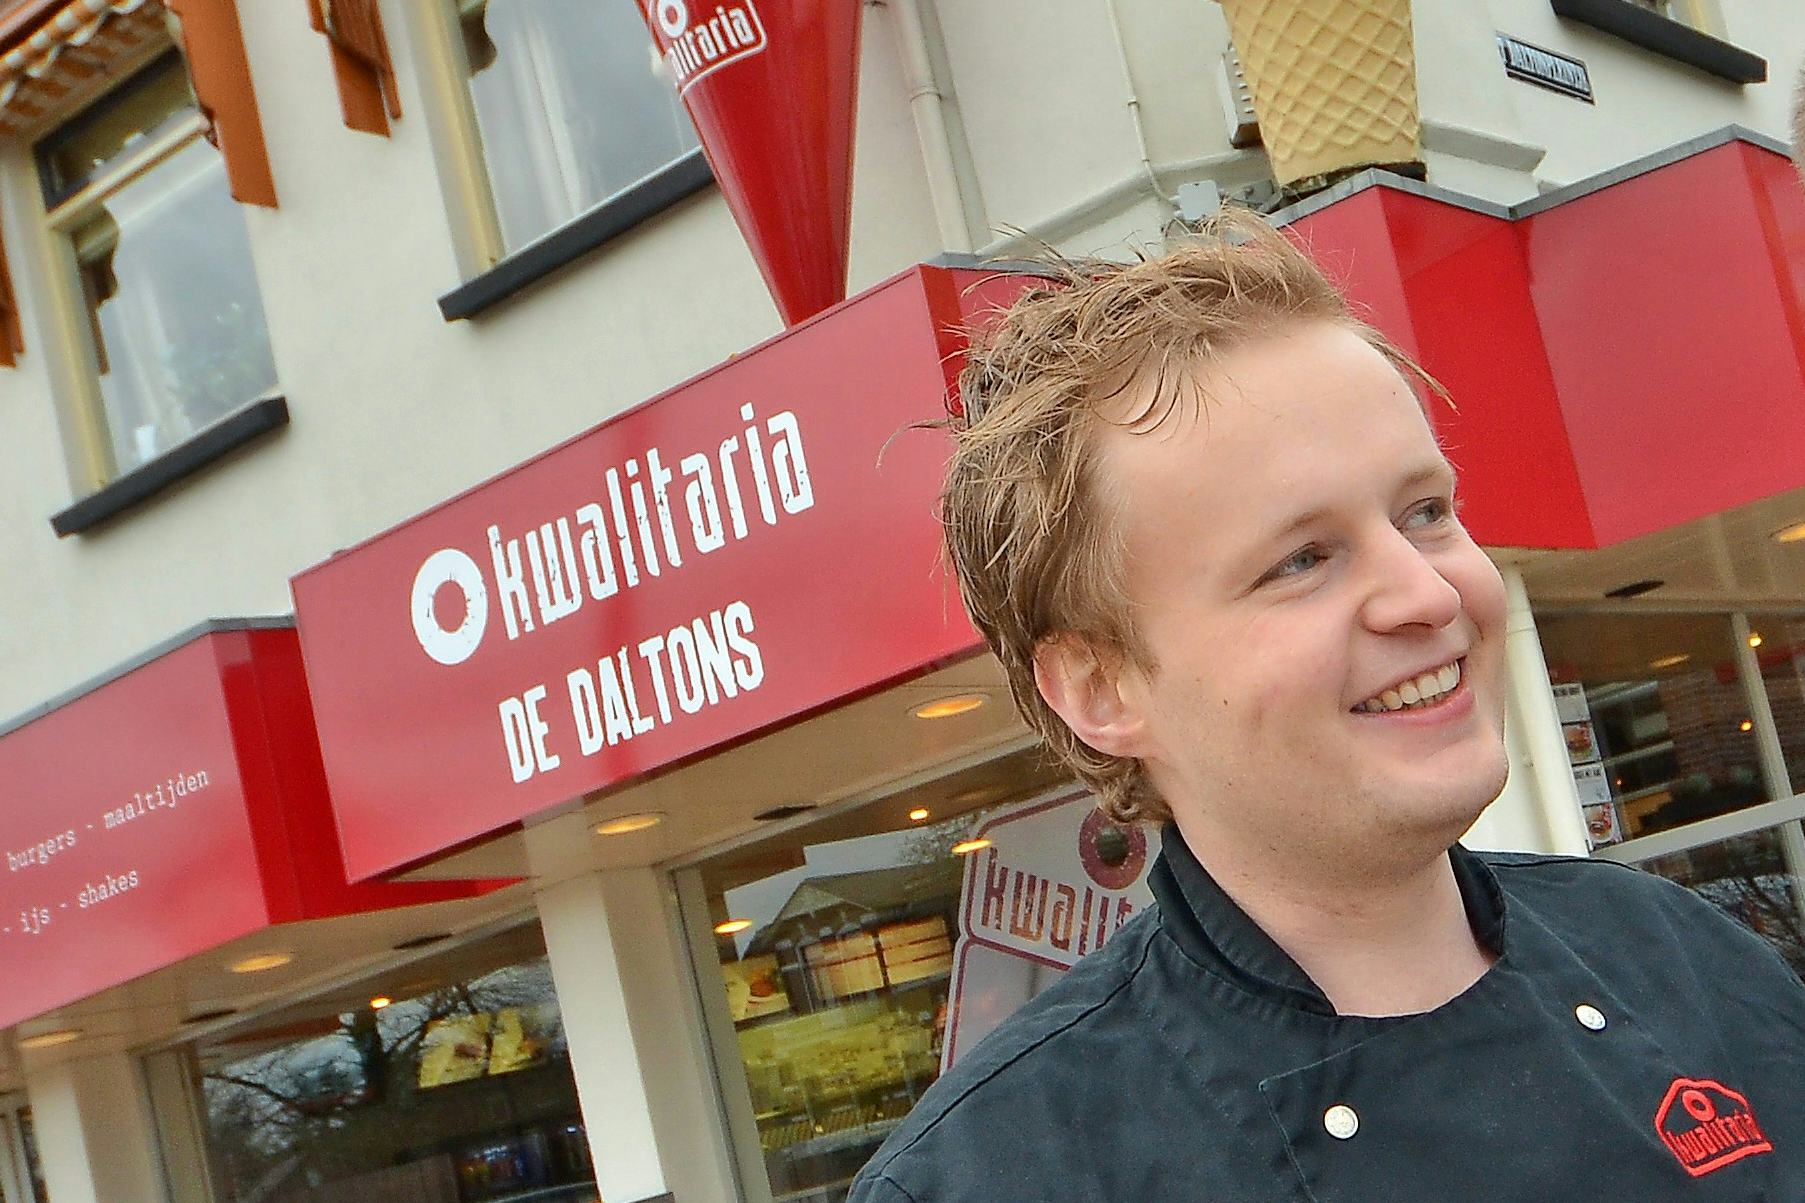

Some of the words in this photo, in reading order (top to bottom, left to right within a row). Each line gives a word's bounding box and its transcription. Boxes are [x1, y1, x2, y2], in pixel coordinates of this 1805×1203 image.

[487, 402, 814, 640] kwalitaria
[500, 685, 560, 784] DE
[567, 600, 765, 756] DALTONS
[6, 830, 77, 872] burgers
[103, 770, 209, 829] maaltijden
[20, 907, 50, 934] ijs
[79, 870, 139, 908] shakes
